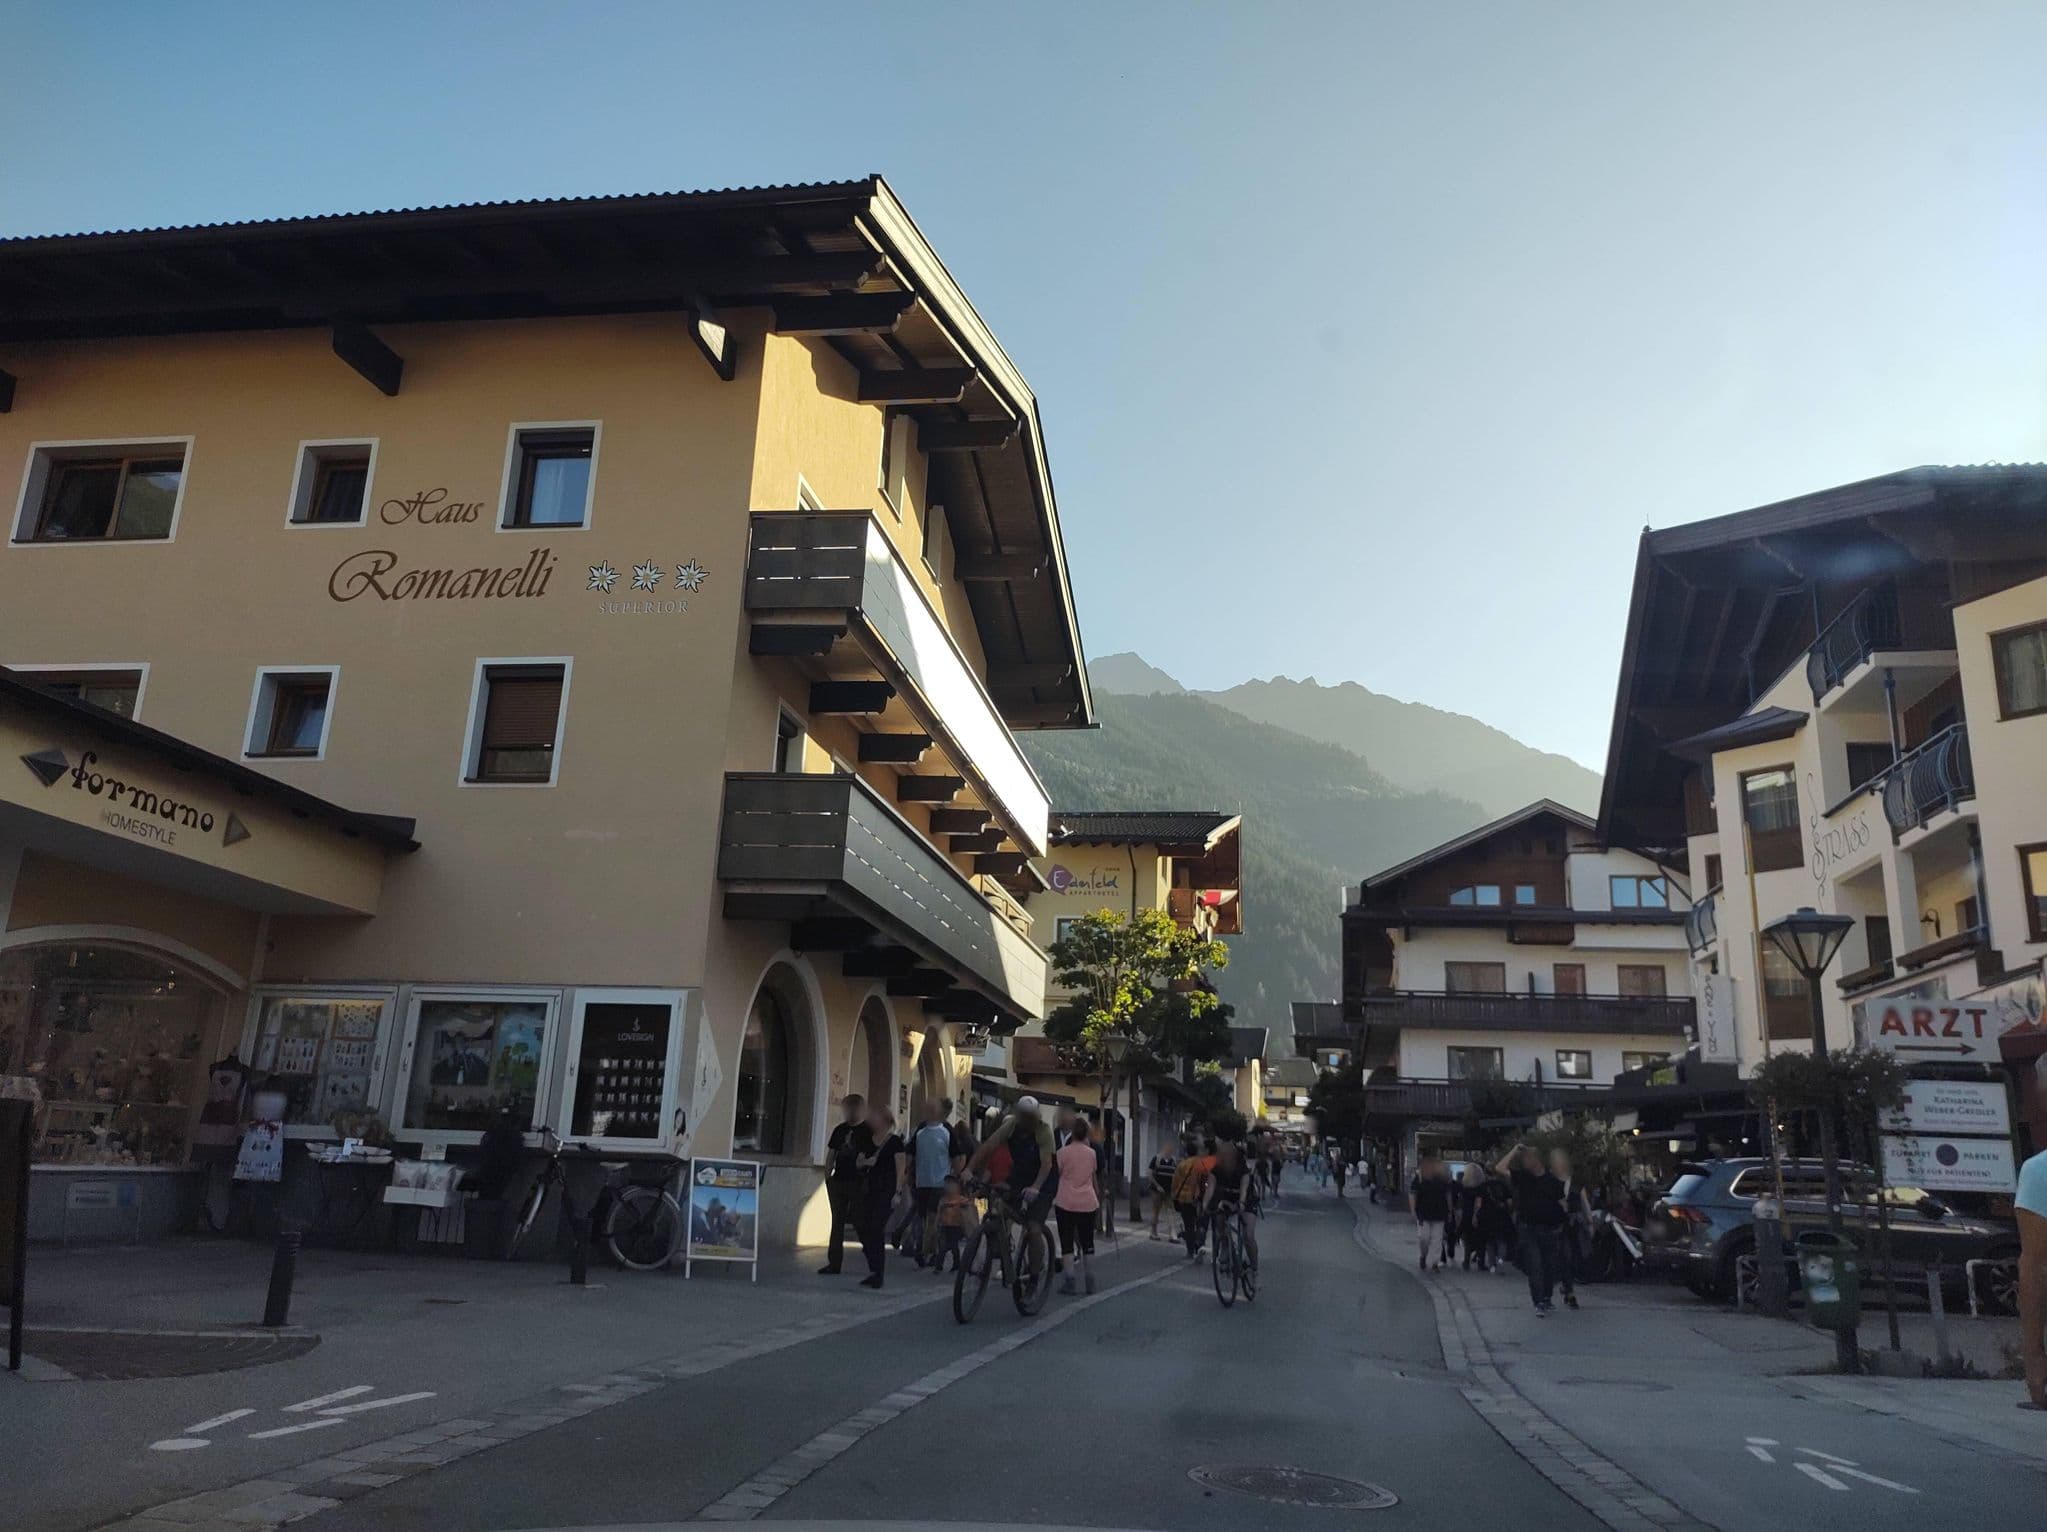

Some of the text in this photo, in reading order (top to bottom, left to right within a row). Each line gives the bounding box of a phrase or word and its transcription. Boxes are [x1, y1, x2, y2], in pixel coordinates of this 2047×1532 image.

[380, 487, 485, 525] Haus
[328, 547, 559, 602] Romanelli
[599, 599, 689, 615] SUPERIOR
[71, 751, 214, 833] formano
[103, 810, 177, 846] HOMESTYLE
[1880, 1005, 1987, 1039] ARZT
